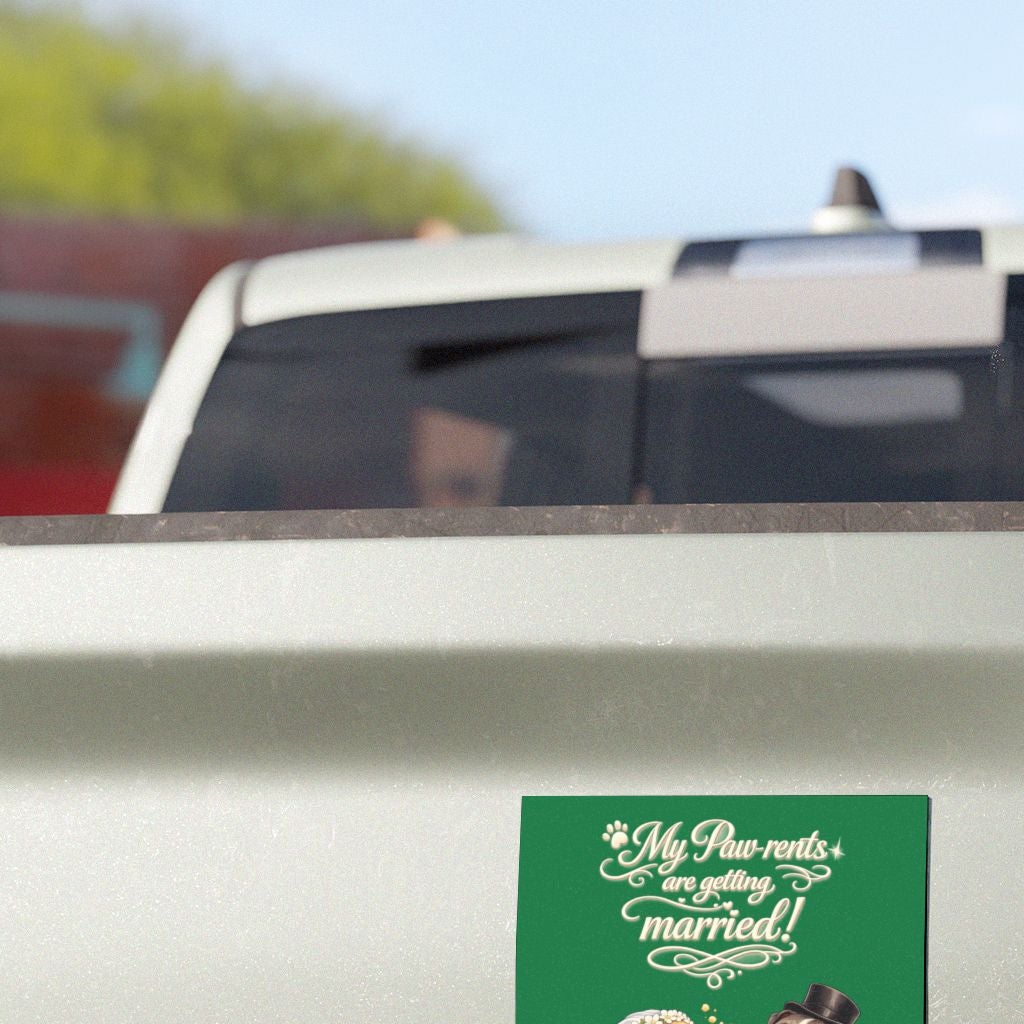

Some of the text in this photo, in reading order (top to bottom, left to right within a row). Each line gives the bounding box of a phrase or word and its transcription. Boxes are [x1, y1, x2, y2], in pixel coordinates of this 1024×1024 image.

[618, 818, 828, 875] My Paw-rents
[661, 868, 776, 905] are getting
[638, 896, 806, 943] married!
